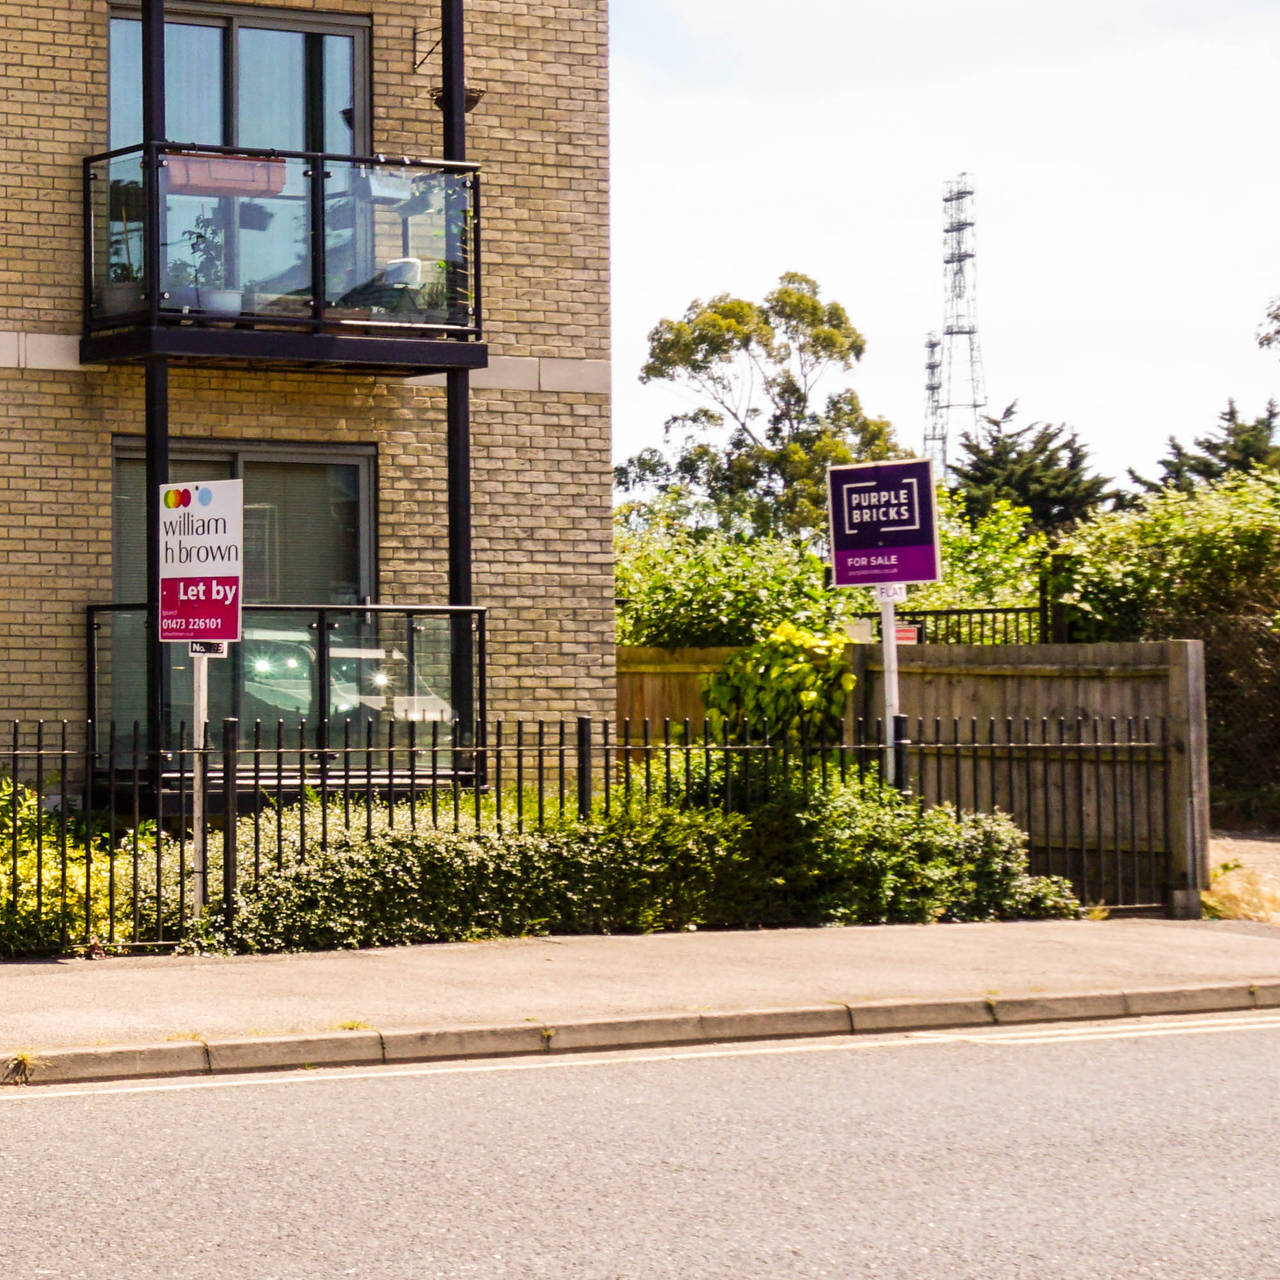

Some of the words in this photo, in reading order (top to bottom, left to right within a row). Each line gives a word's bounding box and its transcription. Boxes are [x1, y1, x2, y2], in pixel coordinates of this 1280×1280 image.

[851, 490, 909, 507] PURPLE
[852, 506, 910, 523] BRICKS
[163, 512, 226, 536] william
[165, 540, 175, 564] h
[178, 539, 239, 564] brown
[847, 557, 868, 567] FOR
[870, 555, 899, 566] SALE
[179, 581, 206, 600] Let
[211, 579, 237, 605] by
[880, 587, 905, 598] FLAT
[162, 618, 186, 630] 01473
[188, 618, 223, 630] 226101
